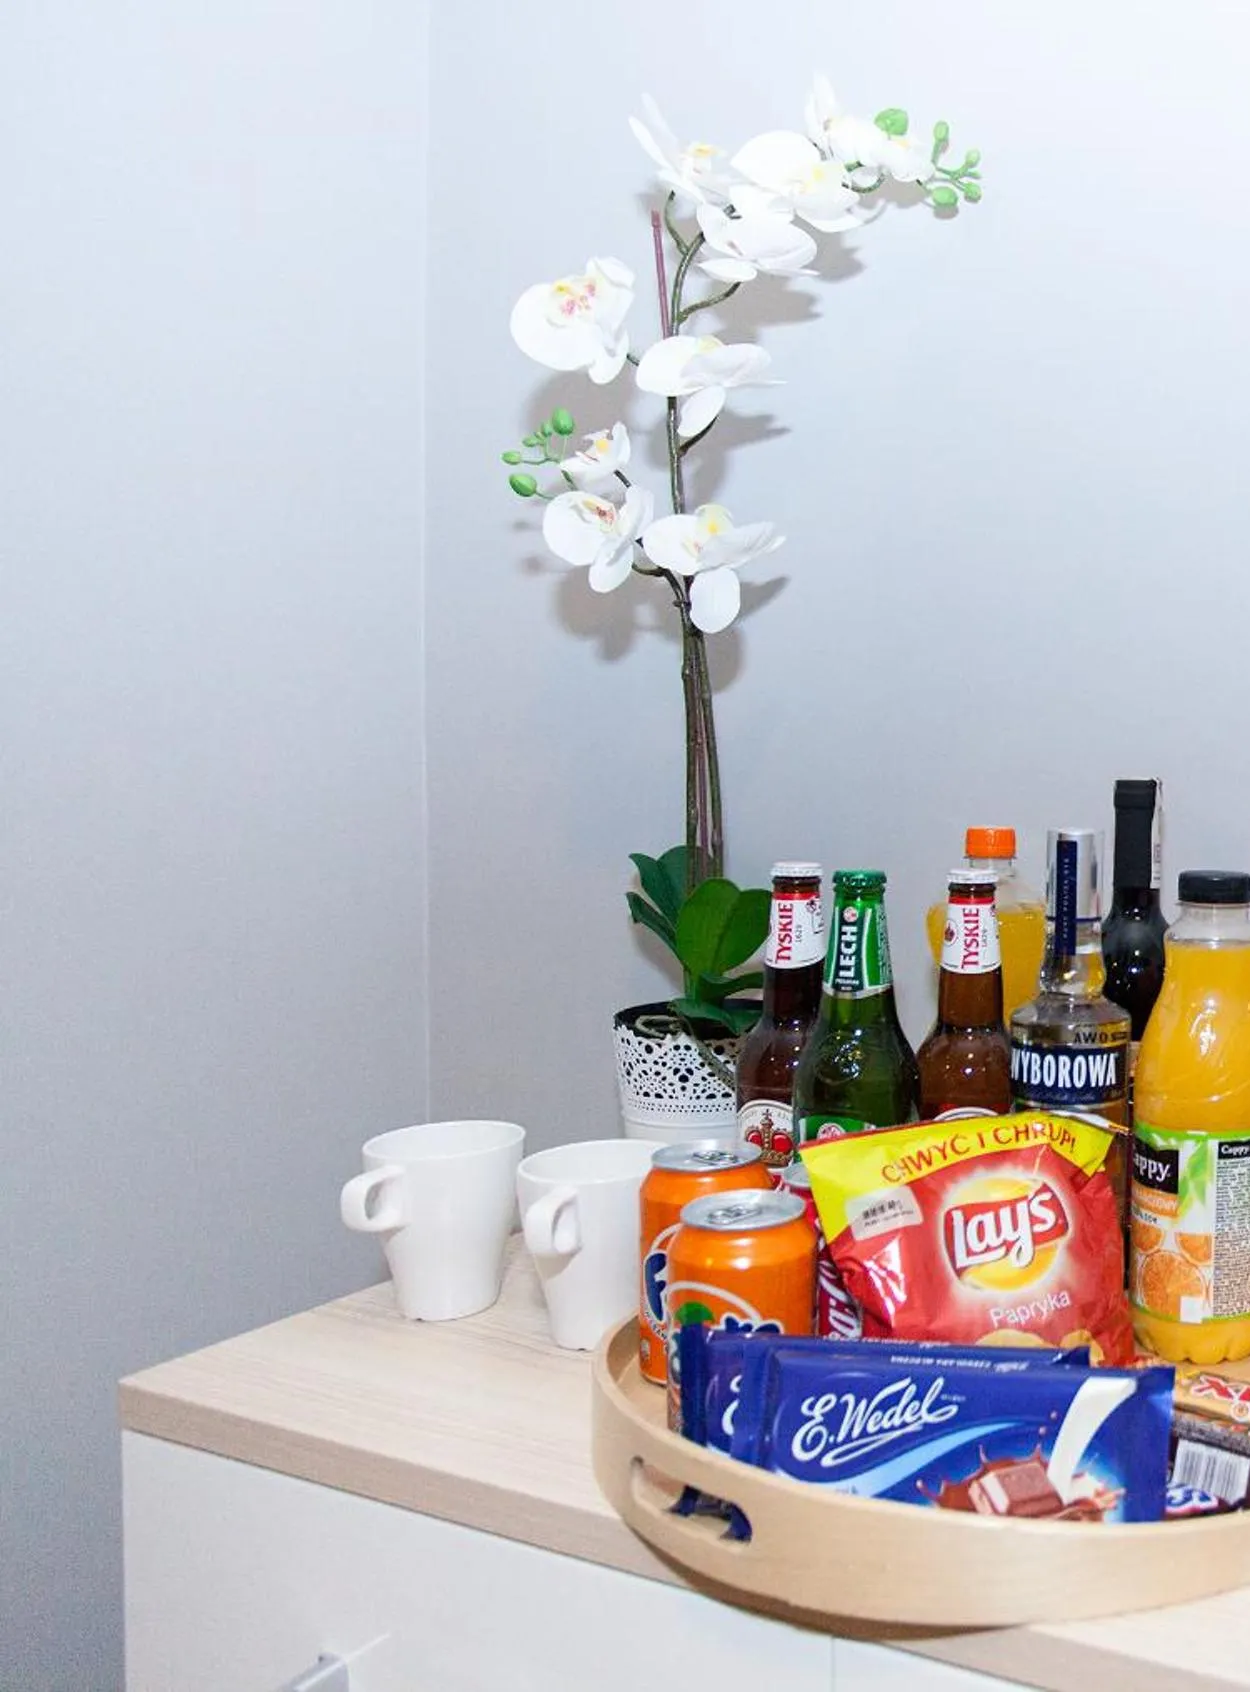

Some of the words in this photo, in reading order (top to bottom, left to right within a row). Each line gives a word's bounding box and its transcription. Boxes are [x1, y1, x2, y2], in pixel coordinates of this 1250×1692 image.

[775, 902, 794, 964] TYSKIE
[838, 924, 858, 978] LECH
[961, 907, 980, 969] TYSKIE
[1010, 1047, 1118, 1089] WYBOROWA
[976, 1131, 986, 1149] I
[1132, 1146, 1170, 1182] appy
[989, 1290, 1072, 1328] Papryka
[791, 1376, 959, 1467] E.Wedel
